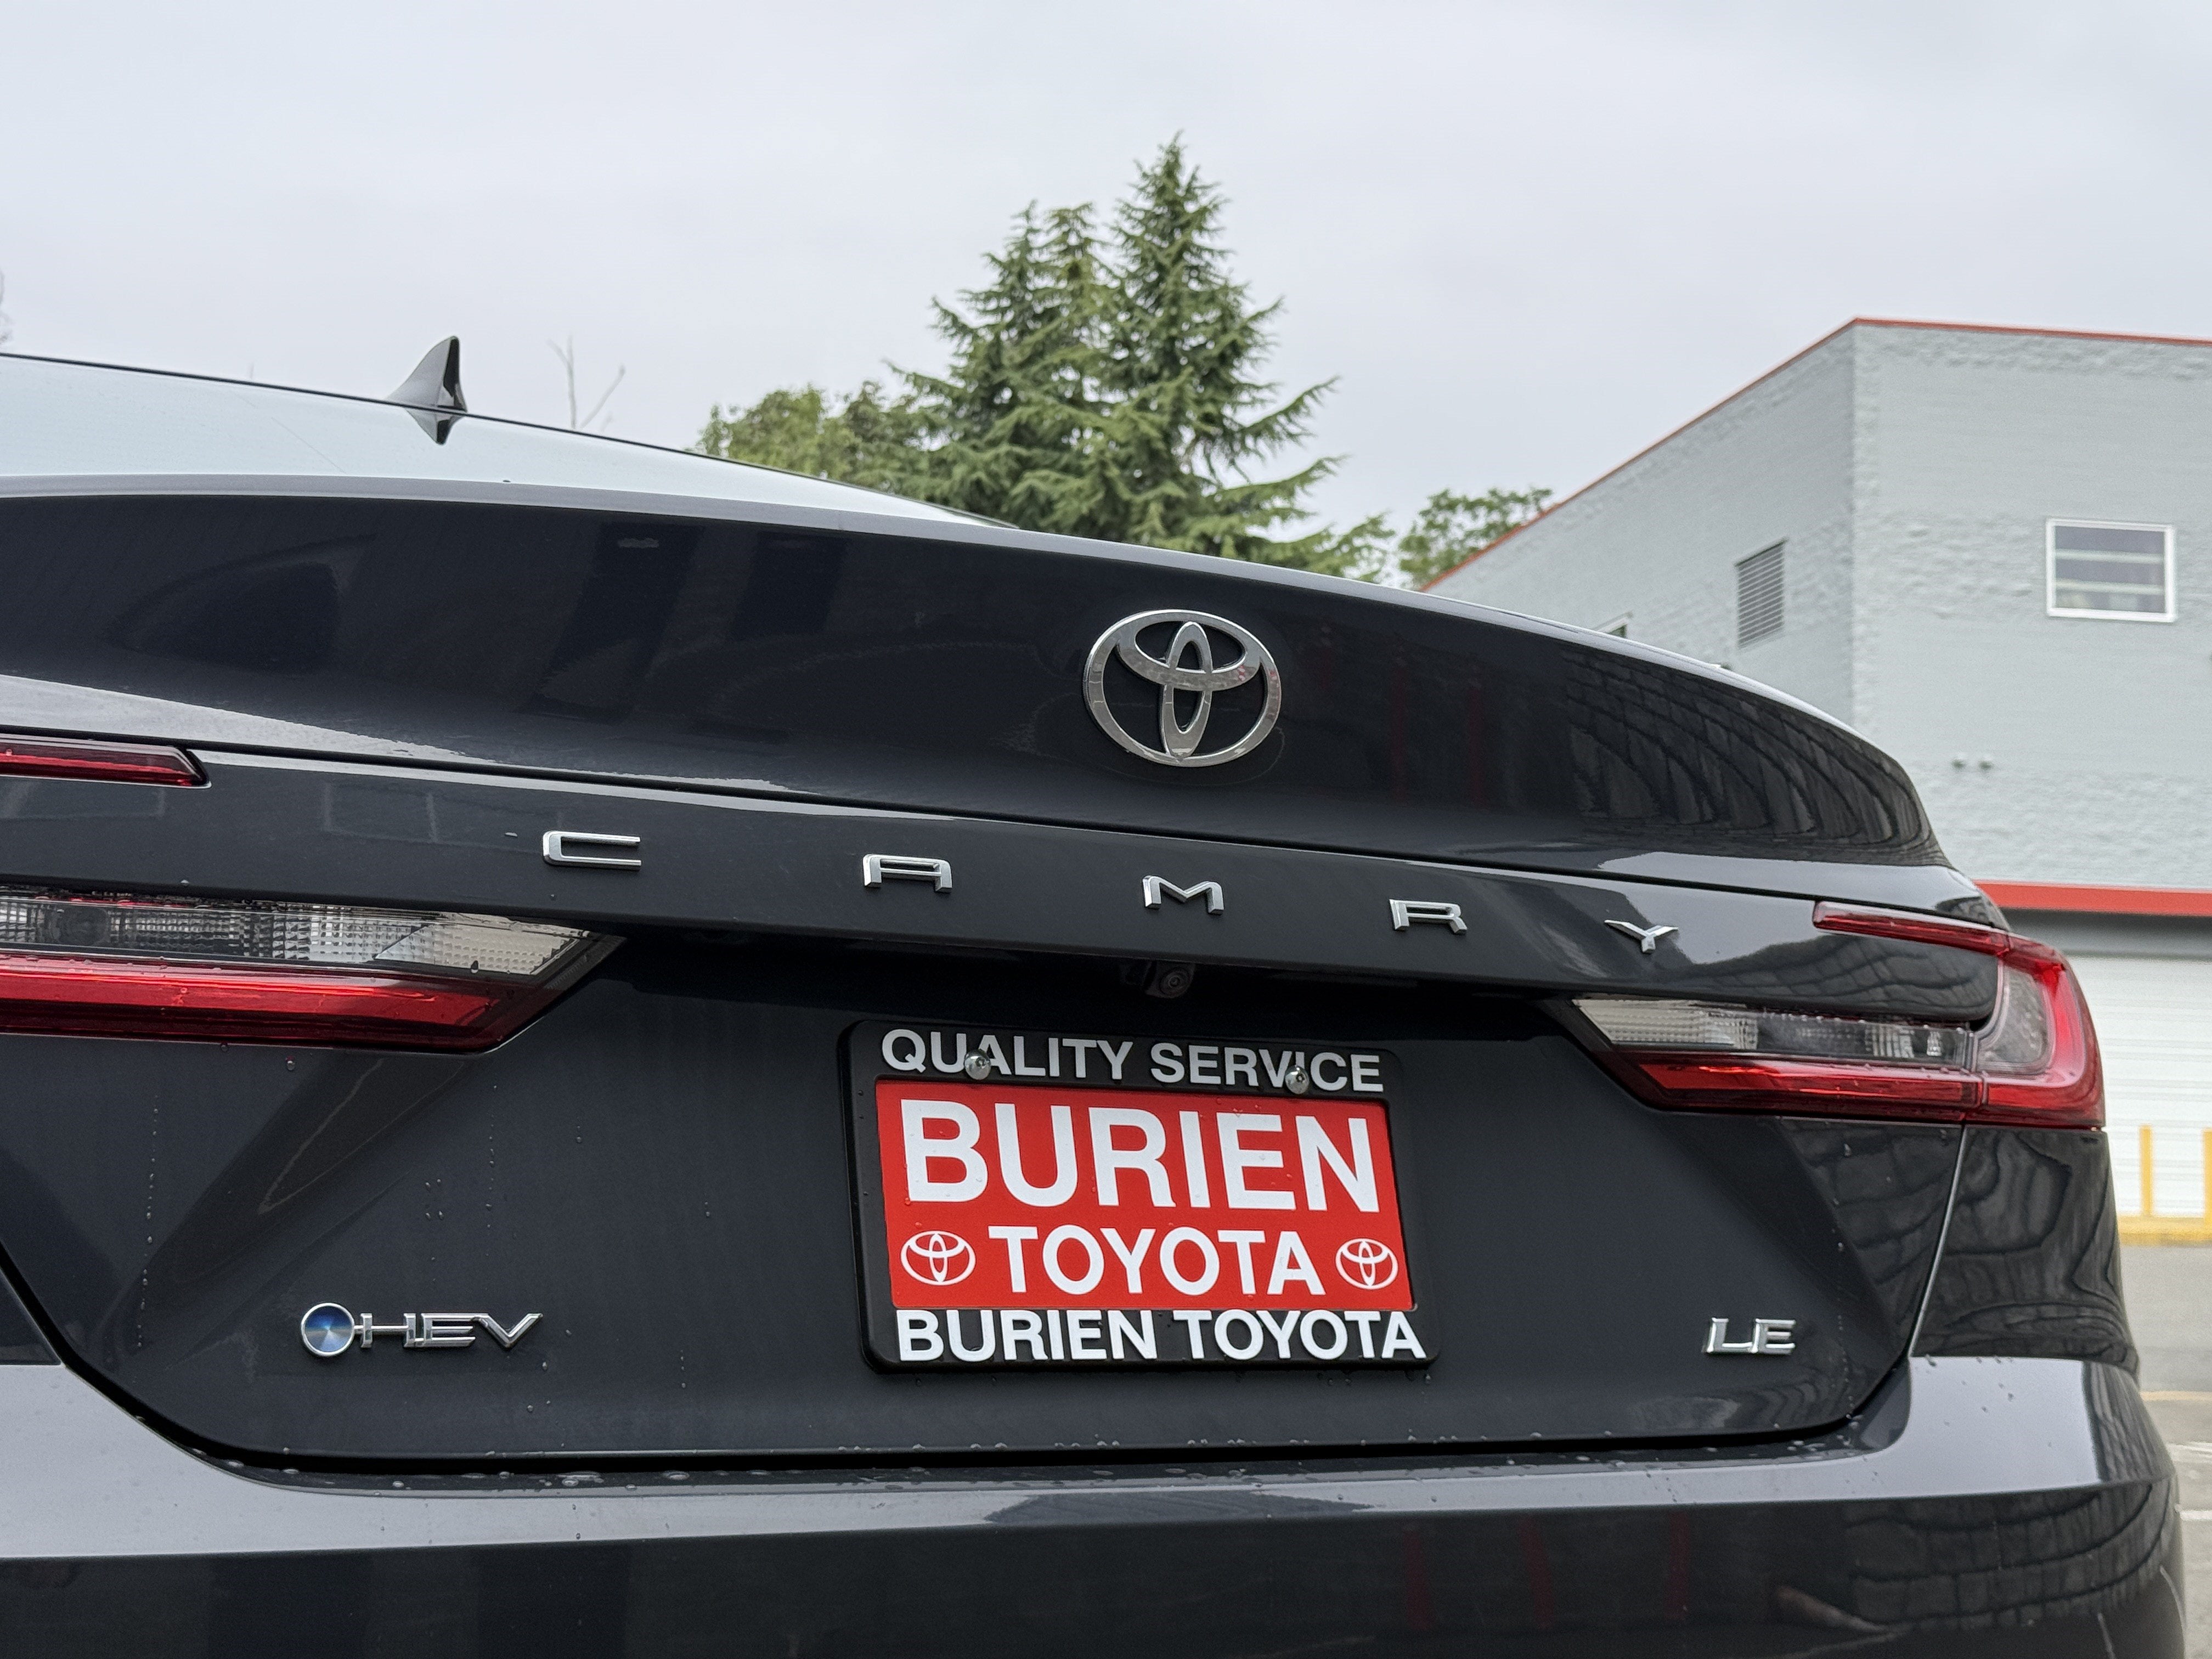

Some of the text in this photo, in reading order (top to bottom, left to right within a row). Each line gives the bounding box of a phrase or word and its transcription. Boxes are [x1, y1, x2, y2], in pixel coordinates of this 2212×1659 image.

[543, 831, 1679, 954] CAMRY
[882, 1029, 1133, 1080] QUALITY
[900, 1098, 1380, 1213] BURIEN
[988, 1224, 1325, 1296] TOYOTA
[896, 1309, 1426, 1362] BURIEN TOYOTA
[1705, 1317, 1796, 1354] LE
